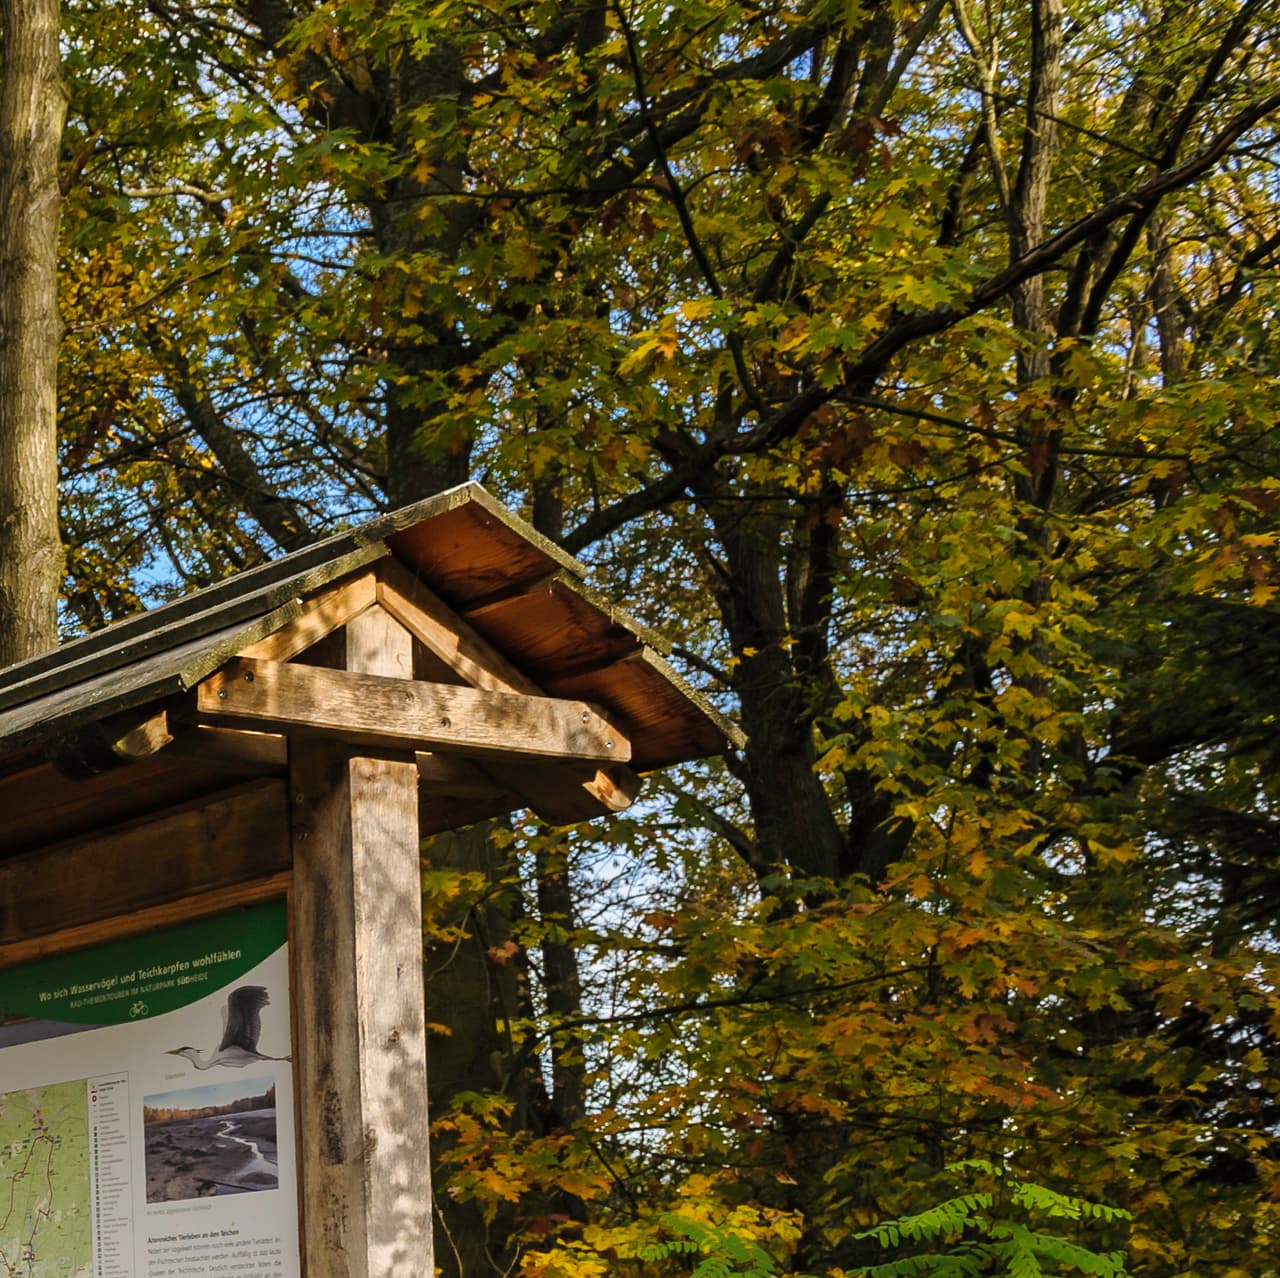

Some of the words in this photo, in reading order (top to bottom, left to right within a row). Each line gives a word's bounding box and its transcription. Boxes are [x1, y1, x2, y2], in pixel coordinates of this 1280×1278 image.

[39, 991, 52, 1002] Wo
[53, 987, 69, 1000] sich
[70, 975, 118, 996] Wasservögel
[120, 970, 135, 984] und
[138, 960, 190, 981] Teichkarpfen
[192, 949, 241, 968] wohlfühlen
[139, 978, 175, 994] NATURPARK
[177, 971, 209, 986] SÜDHEIDE
